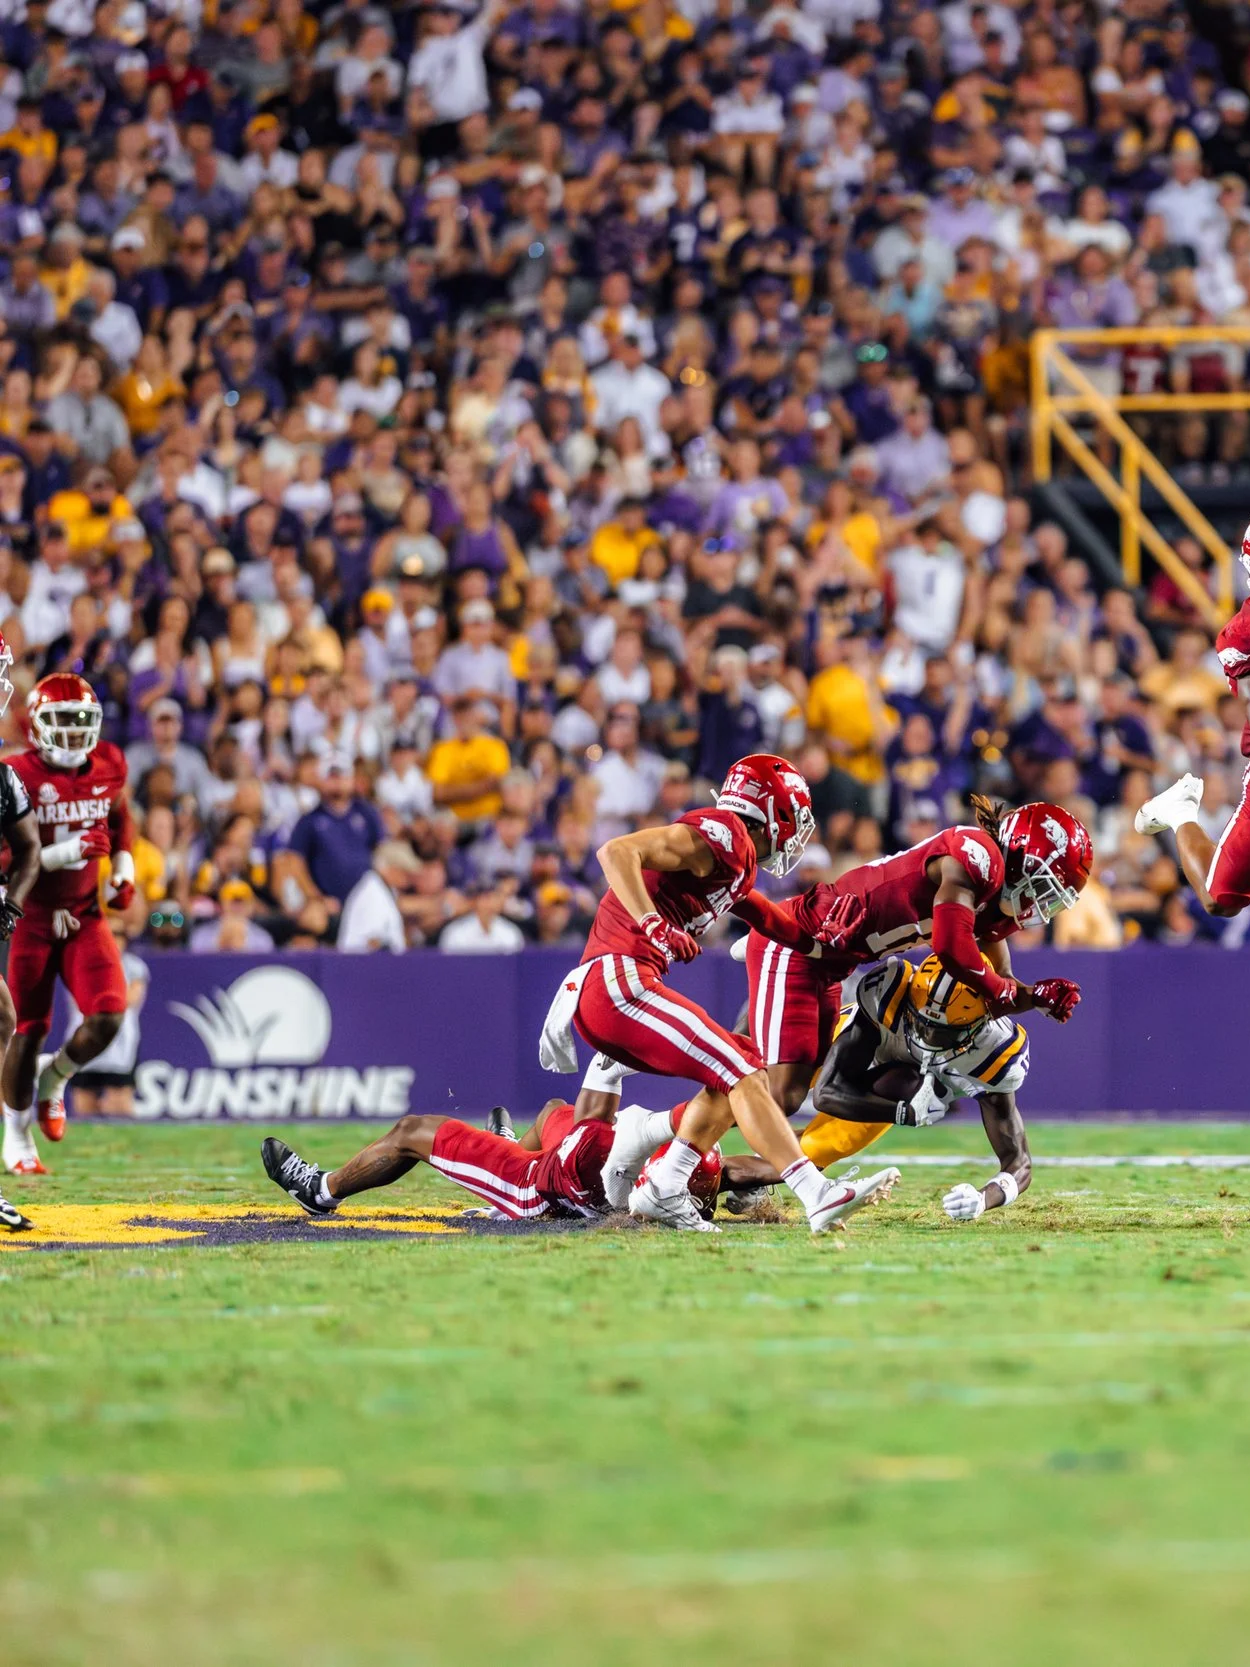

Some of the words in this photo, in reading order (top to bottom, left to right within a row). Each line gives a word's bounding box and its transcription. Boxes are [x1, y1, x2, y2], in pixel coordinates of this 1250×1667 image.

[36, 797, 111, 824] ARKANSAS
[925, 1009, 941, 1020] LSU
[134, 1060, 416, 1118] SUNSHINE
